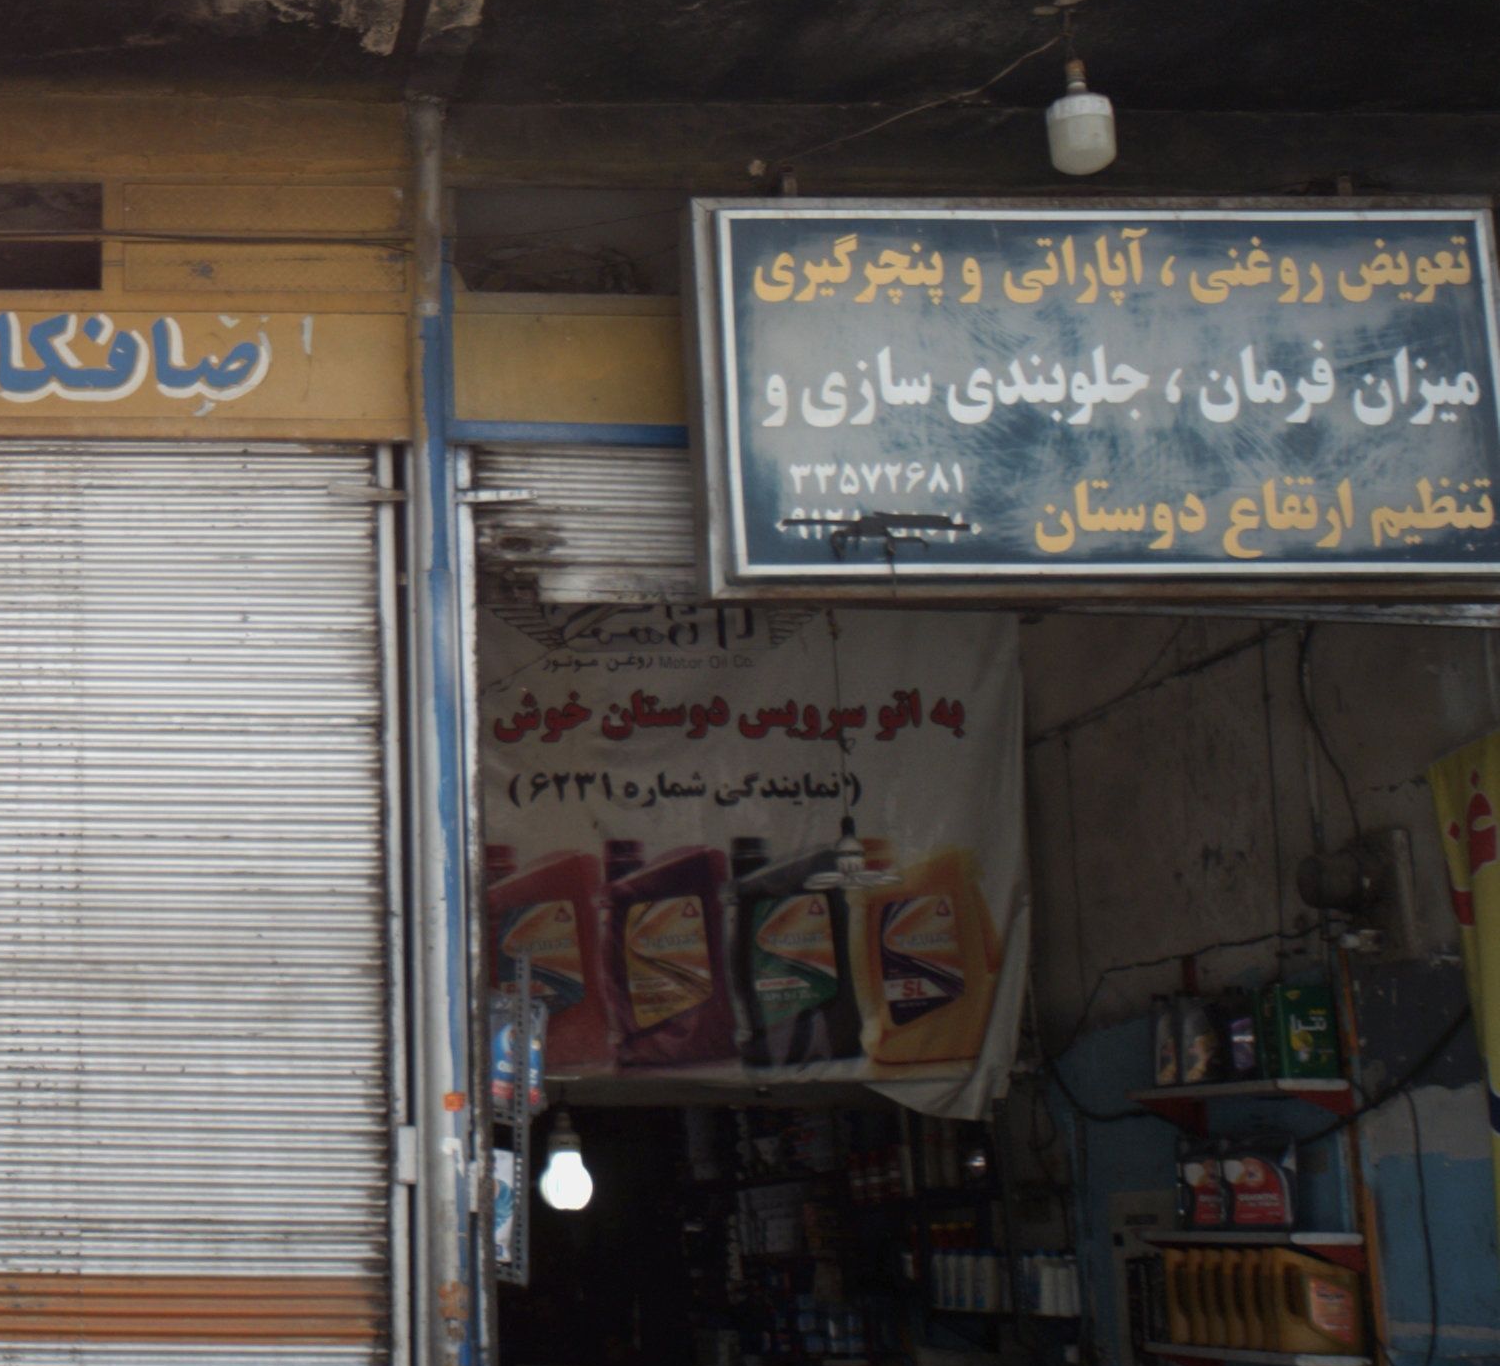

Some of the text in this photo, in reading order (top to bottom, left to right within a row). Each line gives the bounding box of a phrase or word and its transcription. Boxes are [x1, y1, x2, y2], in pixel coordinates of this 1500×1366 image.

[752, 233, 945, 306] پنچرگیری
[960, 257, 983, 304] و
[1002, 227, 1149, 306] آپاراتی
[1190, 235, 1323, 304] روغنی
[1338, 235, 1472, 305] تعویض
[760, 373, 788, 427] و
[801, 346, 932, 427] سازی
[946, 345, 1150, 426] جلوبندی
[1197, 339, 1336, 423] فرمان
[1352, 346, 1481, 426] میزان
[788, 460, 964, 494] ۳۳۵۷۲۶۸۱
[1033, 474, 1495, 558] تنظیم ارتفاع دوستان
[493, 687, 966, 743] به اتو سرویس دوستان خوش
[622, 771, 705, 807] شماره
